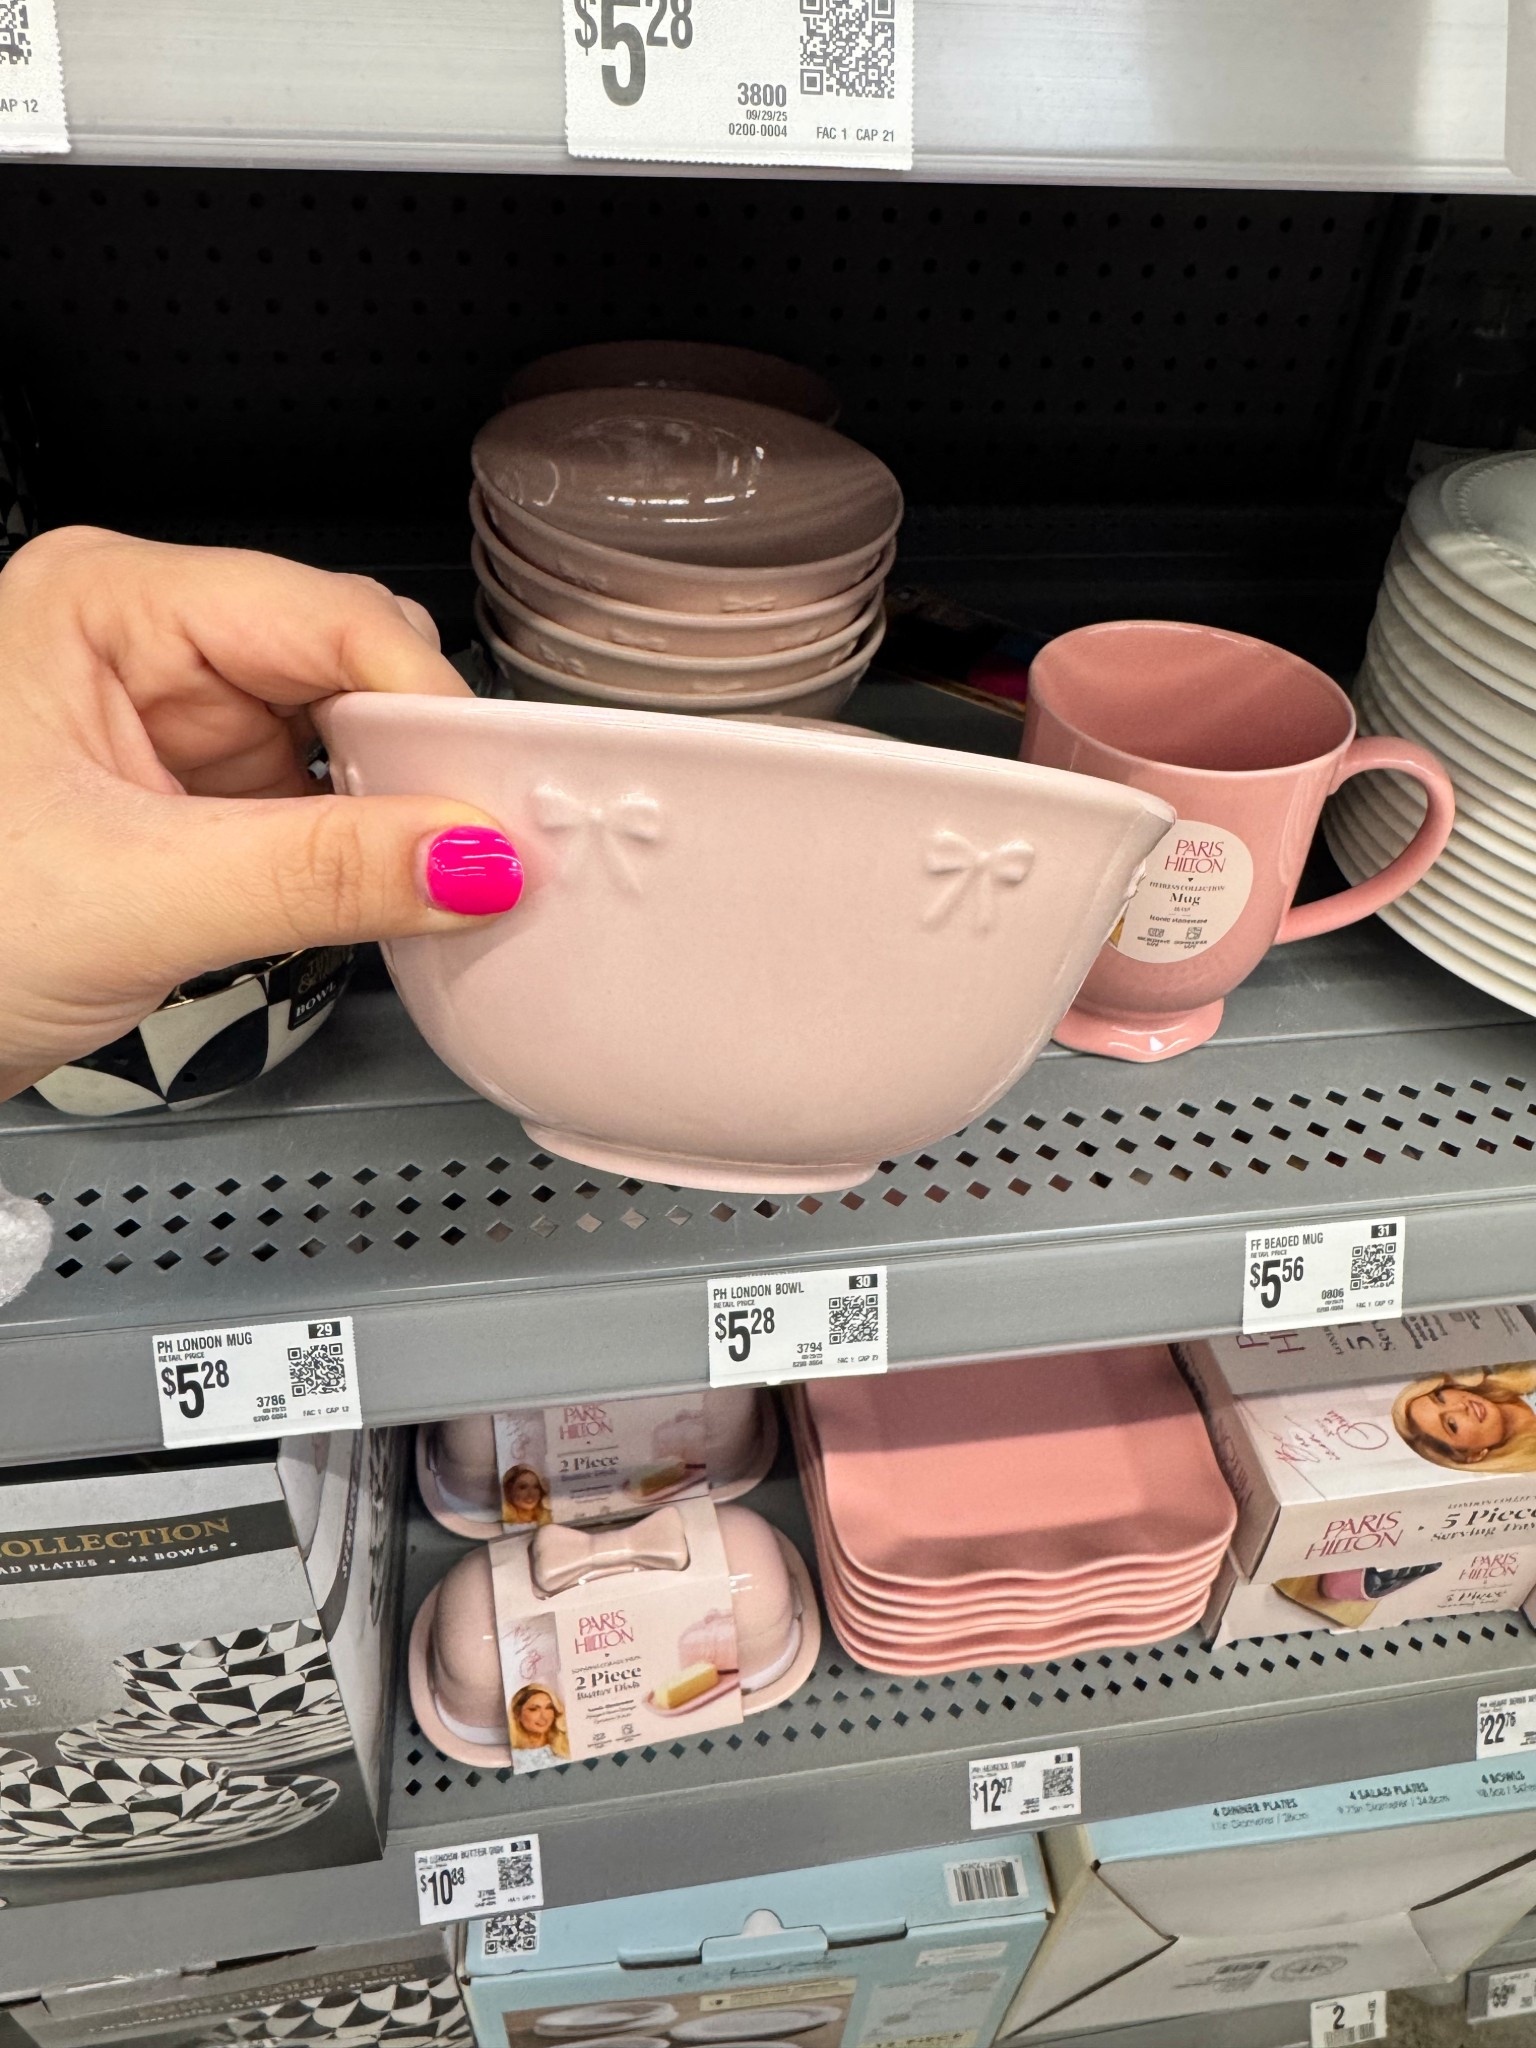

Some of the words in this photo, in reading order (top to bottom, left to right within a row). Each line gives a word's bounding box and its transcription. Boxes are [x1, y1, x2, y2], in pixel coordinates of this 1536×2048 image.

[737, 83, 787, 108] 3800
[0, 98, 17, 112] AP
[22, 98, 39, 113] 12
[746, 110, 788, 122] 09/29/25
[728, 123, 788, 138] 0200-0004
[816, 127, 837, 140] FAC
[841, 128, 848, 141] 1
[856, 128, 878, 142] CAP
[882, 130, 895, 143] 21
[1175, 839, 1224, 858] PARIS
[1164, 857, 1227, 874] HILTON
[1169, 892, 1201, 906] Mug
[1377, 1225, 1390, 1237] 31
[1250, 1239, 1262, 1251] FF
[1265, 1235, 1299, 1250] BEADED
[1302, 1232, 1324, 1245] MUG
[855, 1276, 871, 1288] 30
[713, 1287, 727, 1301] PH
[731, 1284, 772, 1299] LONDON
[775, 1282, 805, 1295] BOWL
[316, 1323, 333, 1337] 29
[157, 1340, 173, 1354] PH
[177, 1336, 222, 1352] LONDON
[226, 1332, 253, 1346] MUG
[797, 1342, 823, 1354] 3794
[256, 1394, 286, 1408] 3786
[559, 1459, 569, 1473] 2
[1323, 1511, 1402, 1540] PARIS
[1441, 1513, 1461, 1529] 5
[0, 1517, 229, 1557] OLLECTION
[1305, 1529, 1404, 1560] HILTON
[29, 1558, 98, 1573] PLATES
[154, 1543, 219, 1561] BOWLS
[1471, 1552, 1519, 1568] PARIS
[578, 1610, 626, 1636] PARIS
[575, 1676, 587, 1691] 2
[591, 1667, 642, 1687] Piece
[1263, 1798, 1298, 1812] PLATES
[1332, 2005, 1345, 2030] 2
